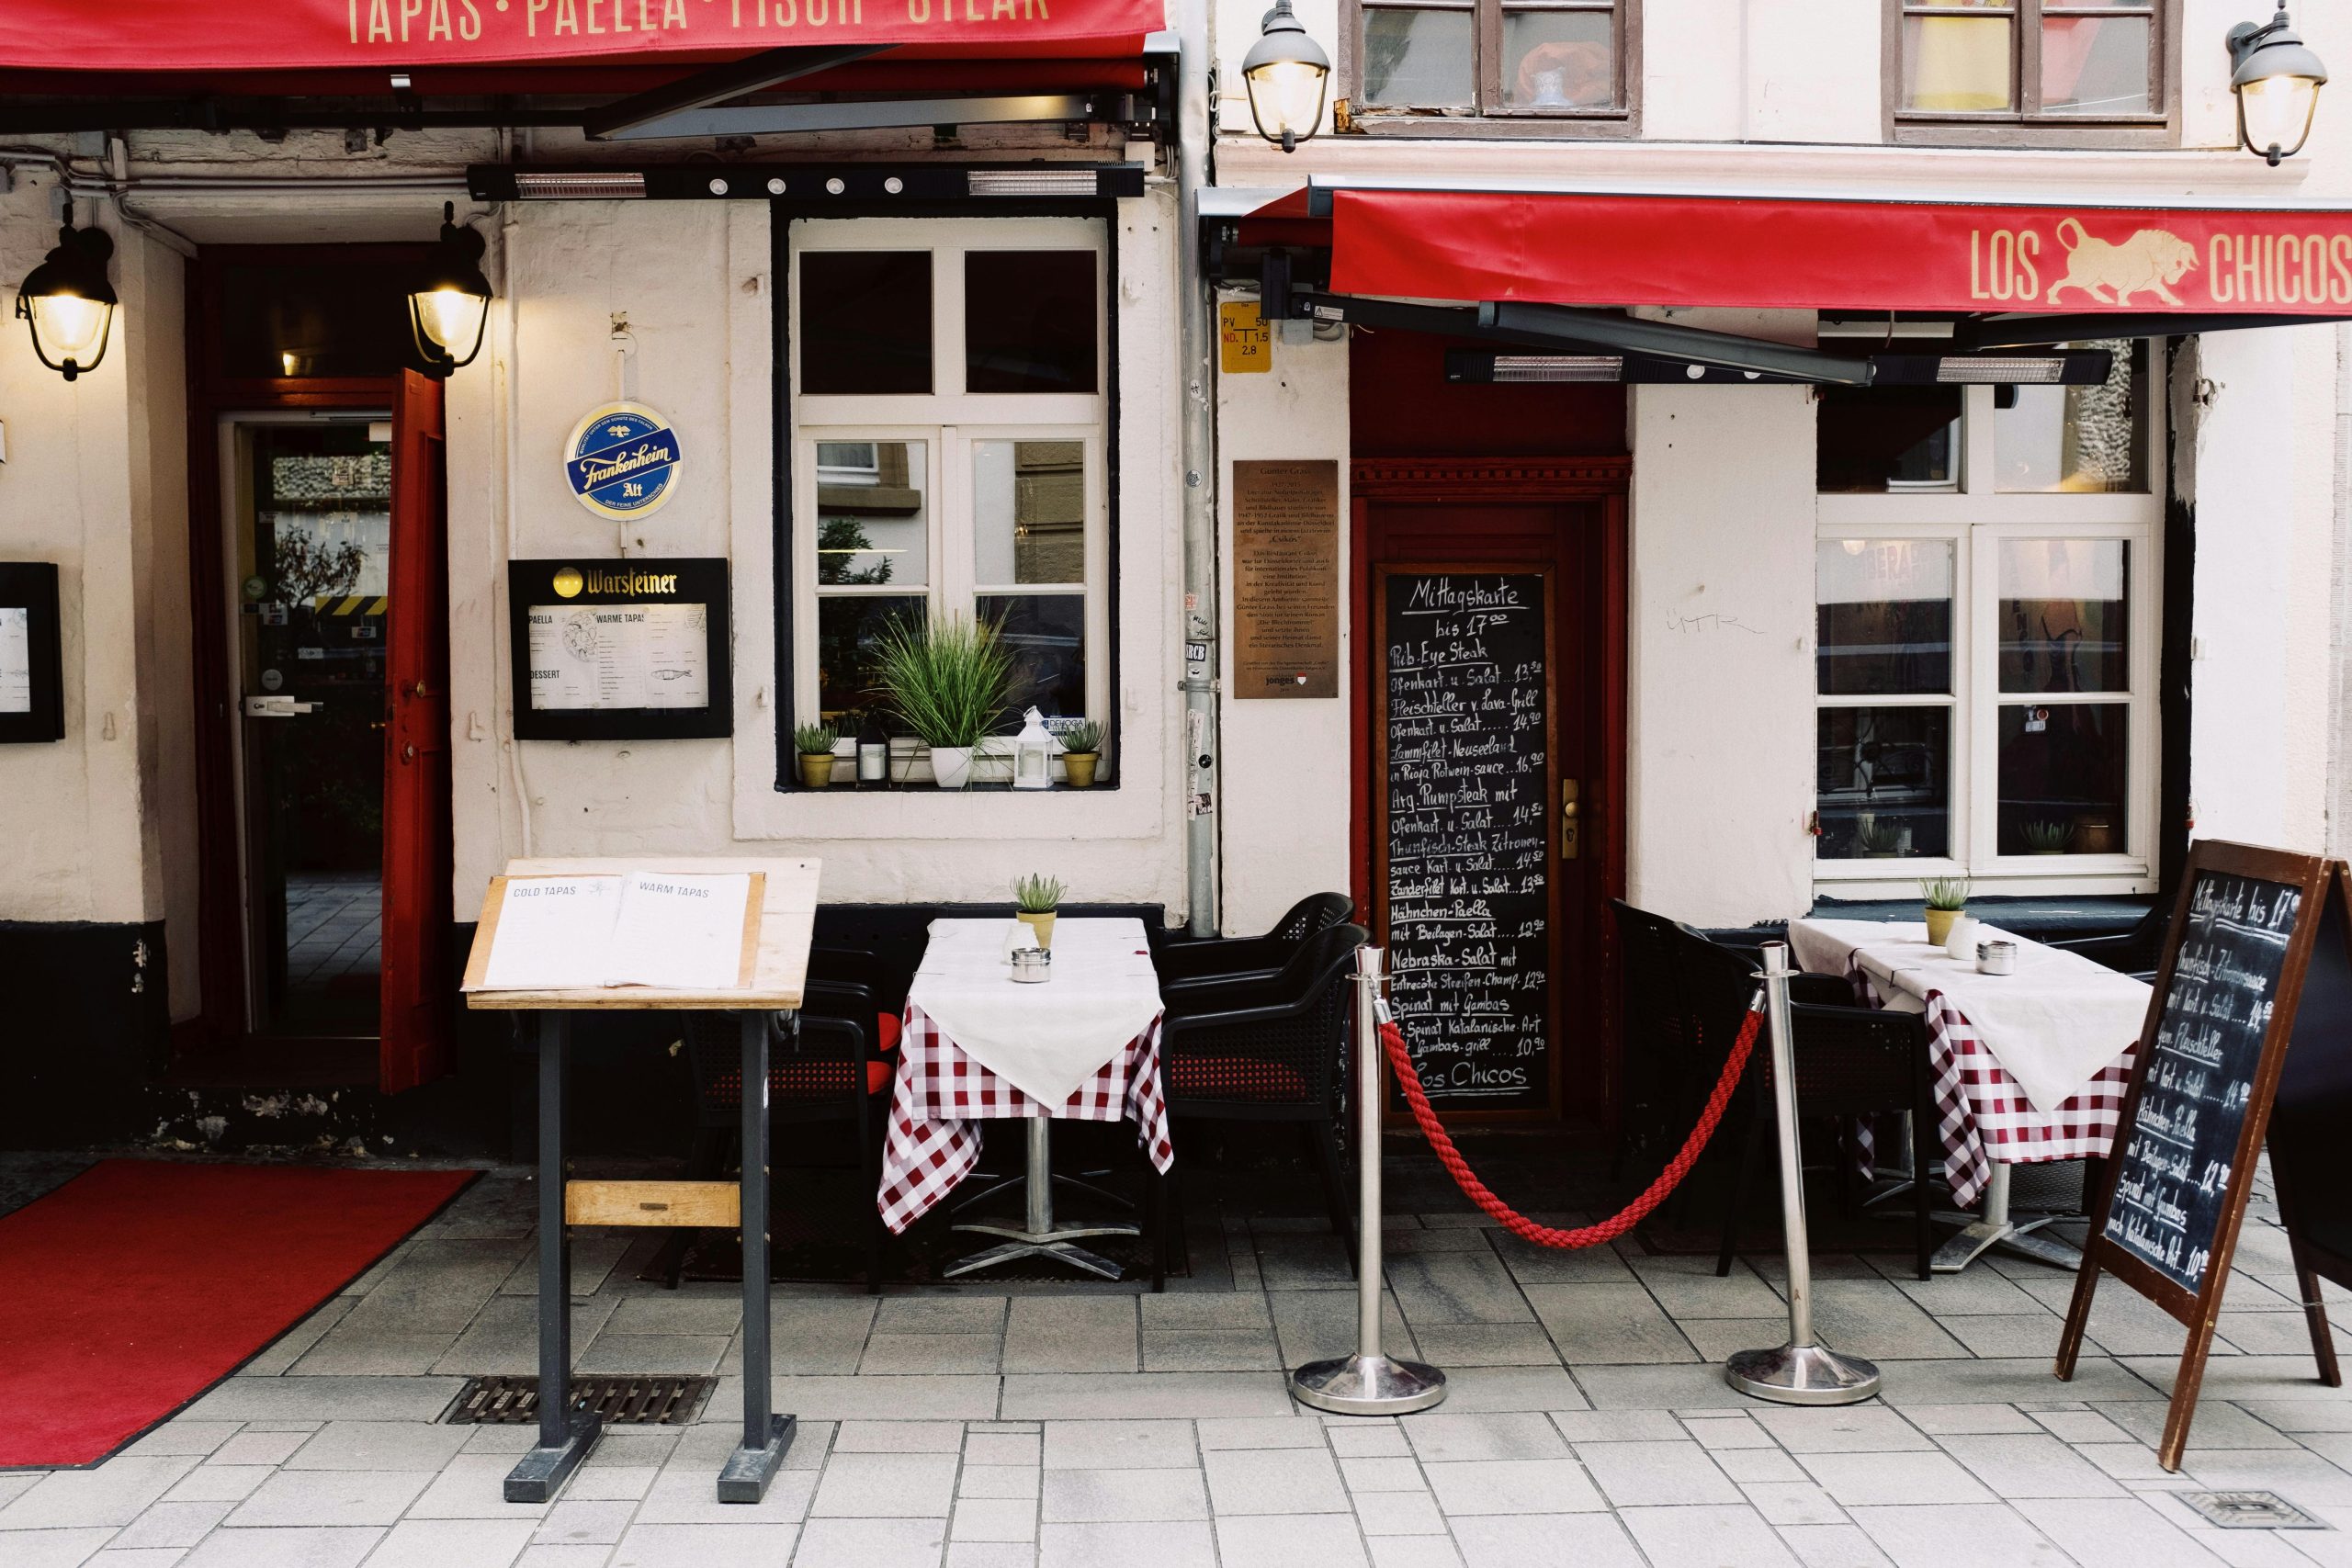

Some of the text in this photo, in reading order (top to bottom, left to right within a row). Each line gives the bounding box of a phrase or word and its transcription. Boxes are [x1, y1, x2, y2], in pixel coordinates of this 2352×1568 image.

[1971, 229, 2352, 304] LOS CHICOS
[1223, 317, 1235, 327] PV
[580, 443, 673, 491] Frankenheim
[605, 499, 616, 507] DER
[632, 483, 663, 507] UNTERSCHIED
[622, 482, 643, 498] Alt
[587, 567, 678, 597] Warsteiner
[1409, 577, 1520, 615] Mittagskarte
[529, 615, 553, 625] PAELLA
[596, 614, 623, 625] WARME
[1436, 619, 1460, 638] bis
[1450, 638, 1488, 662] Steak
[530, 670, 560, 680] DESSERT
[1467, 664, 1502, 687] Salat
[1391, 691, 1467, 718] Fleischteller
[1451, 713, 1482, 733] Salat
[1390, 773, 1400, 783] in
[1401, 763, 1430, 786] Rioja
[1419, 777, 1488, 814] Rumpsteak
[1495, 778, 1519, 802] mit
[1461, 808, 1494, 831] Salat
[1390, 863, 1422, 877] sauce
[1465, 853, 1496, 870] Salat
[514, 886, 576, 898] COLD TAPAS
[639, 881, 710, 899] WARM TAPAS
[1389, 875, 1445, 897] Zanderfilet
[1482, 874, 1511, 895] Salat
[1391, 898, 1492, 921] Hähnchen-Paella
[2247, 886, 2267, 923] bis
[1391, 923, 1411, 942] mit
[1416, 921, 1498, 947] Beilagen-Salat
[1391, 942, 1517, 970] Nebraska-Salat mit
[1391, 989, 1510, 1021] Spinat mit Gambas
[1407, 1017, 1442, 1043] Spinat
[1452, 1061, 1527, 1087] Chicos
